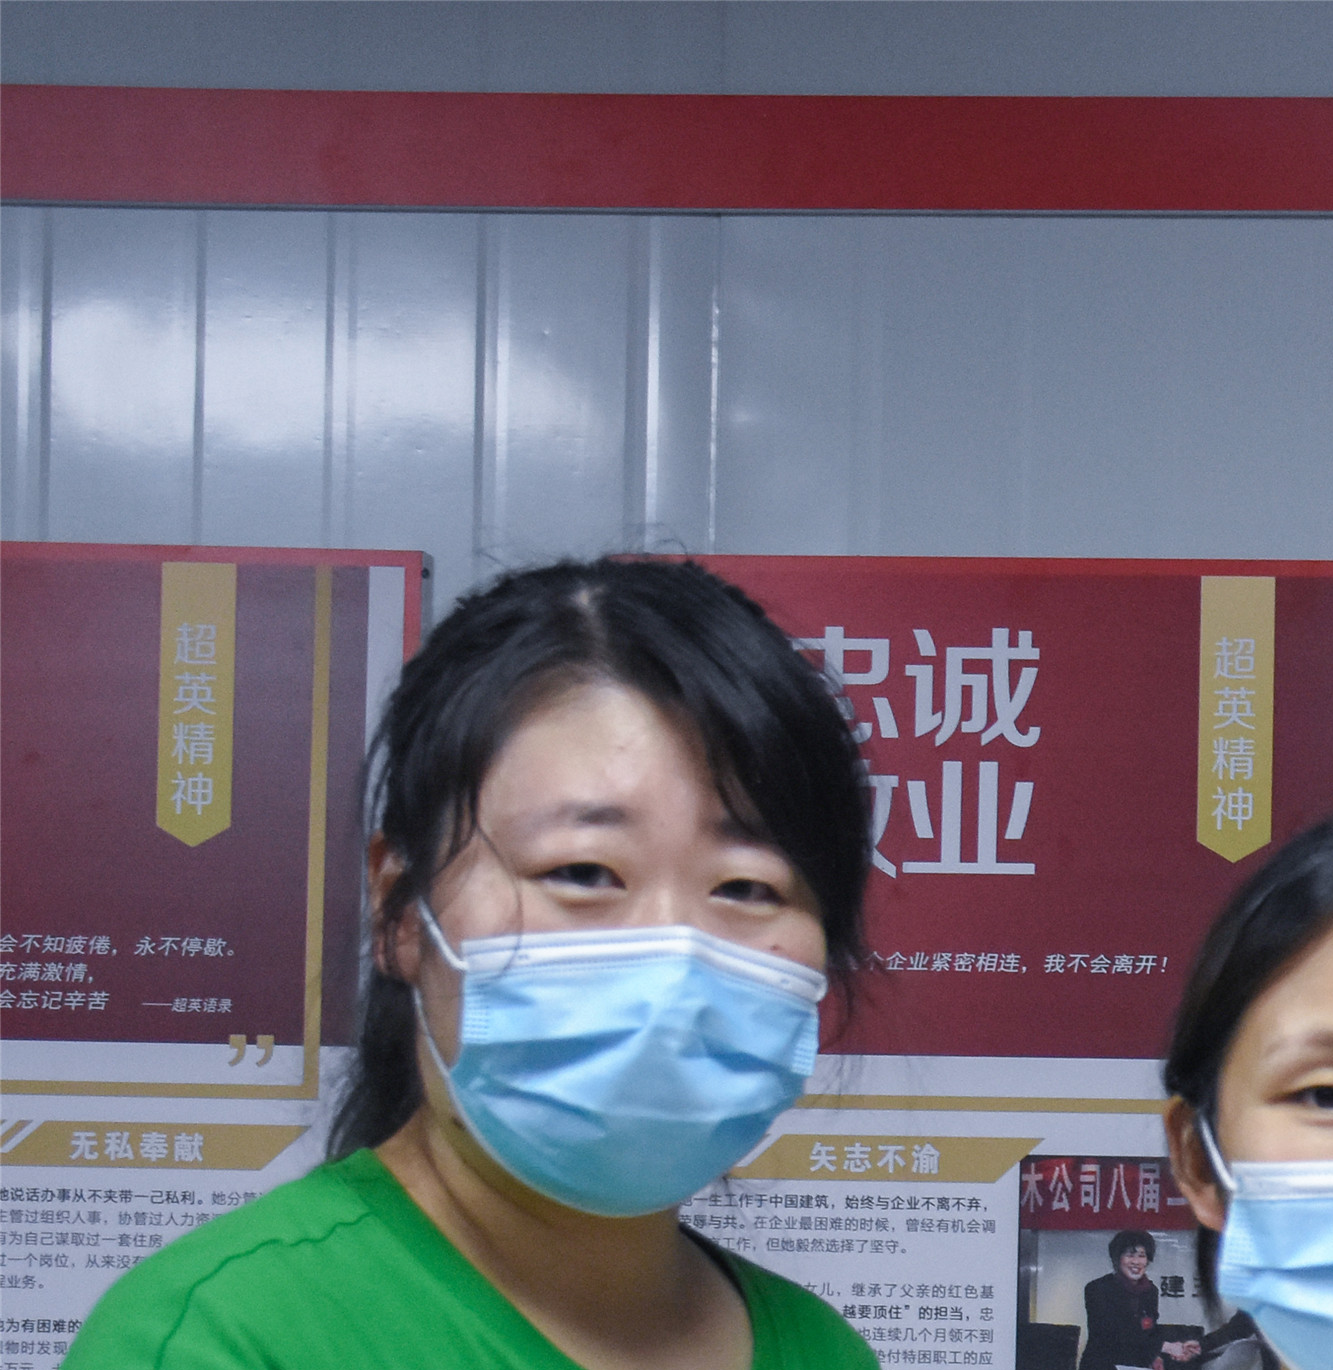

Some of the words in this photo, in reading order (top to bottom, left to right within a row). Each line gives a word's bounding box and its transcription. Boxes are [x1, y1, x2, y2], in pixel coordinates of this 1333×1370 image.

[788, 626, 1042, 748] 忠诚
[172, 623, 217, 815] 超英精神
[1211, 637, 1256, 831] 超英精神
[0, 961, 94, 984] 充满激情，
[846, 951, 1169, 975] 个企业紧密相连，我不会离开！
[0, 989, 110, 1011] 会忘记辛苦
[70, 1131, 204, 1162] 无私奉献
[809, 1143, 941, 1175] 矢志不渝
[711, 1236, 908, 1254] 工作，但她毅然选择了坚守。
[1160, 1275, 1200, 1298] 建
[0, 1340, 68, 1355] 物时发现
